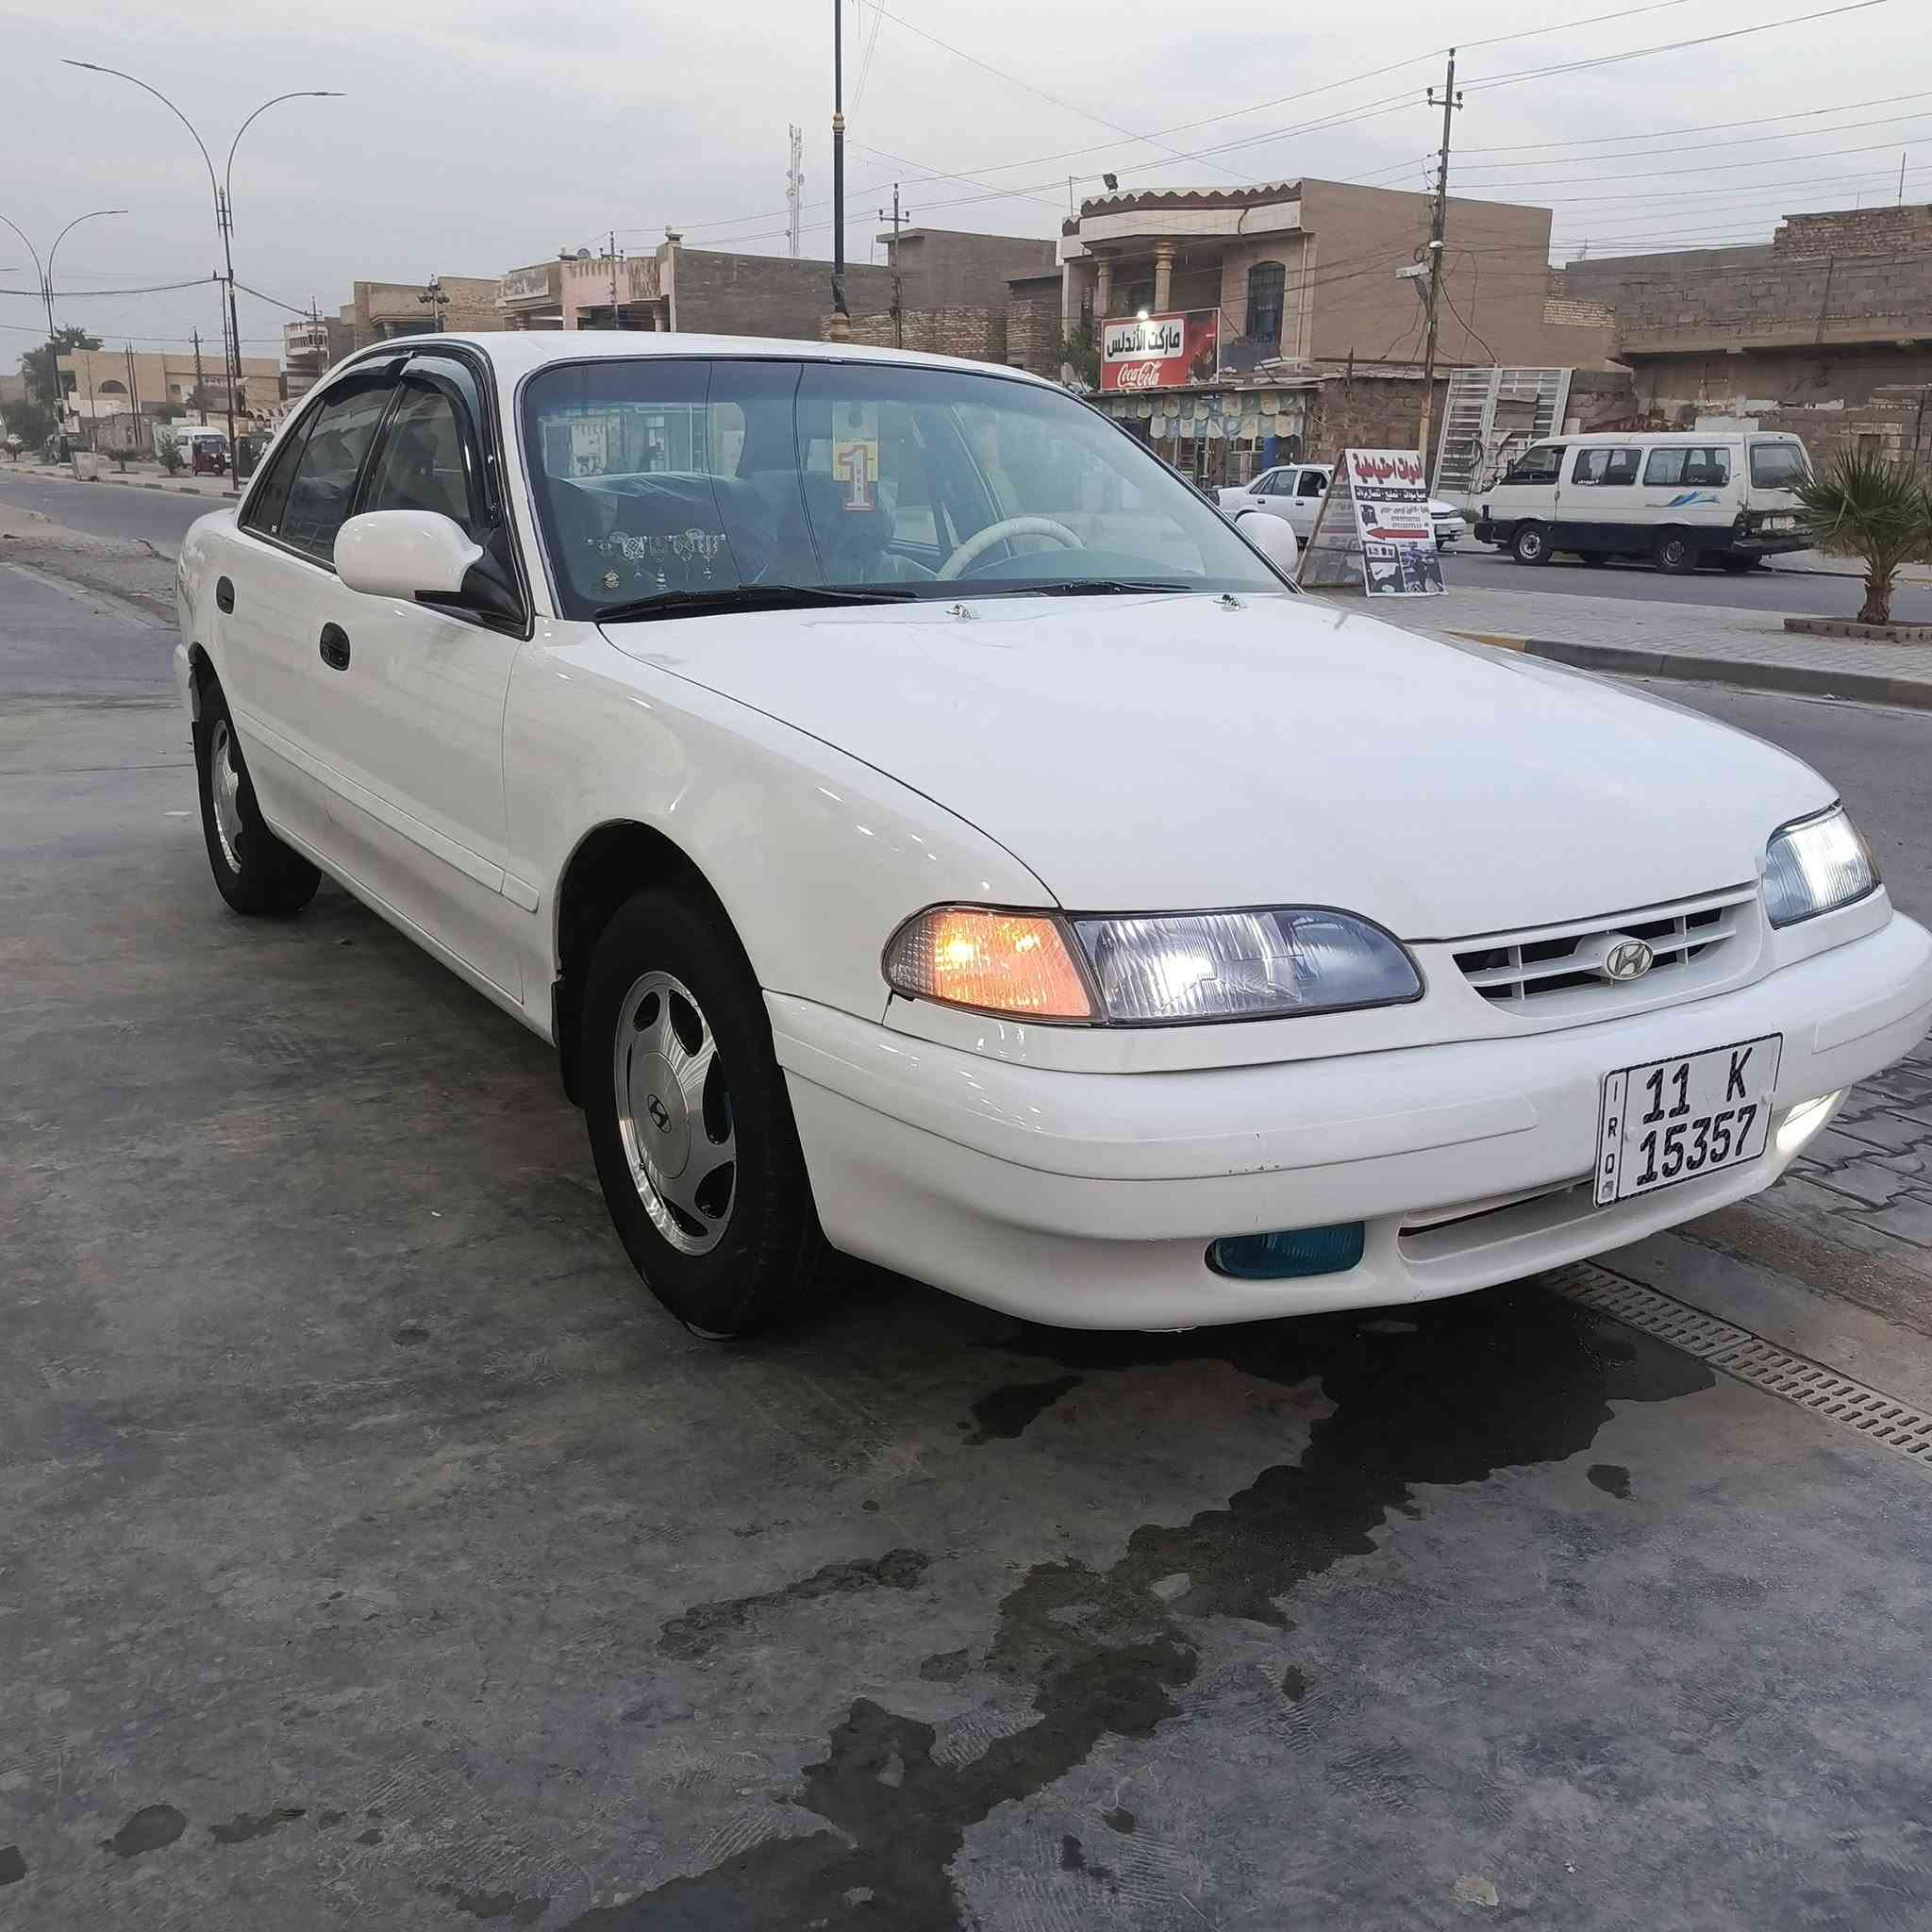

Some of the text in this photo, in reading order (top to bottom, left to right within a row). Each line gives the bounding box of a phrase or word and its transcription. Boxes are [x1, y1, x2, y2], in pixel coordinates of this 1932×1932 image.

[1642, 1046, 1753, 1124] 11 K
[1636, 1103, 1758, 1186] 15357
